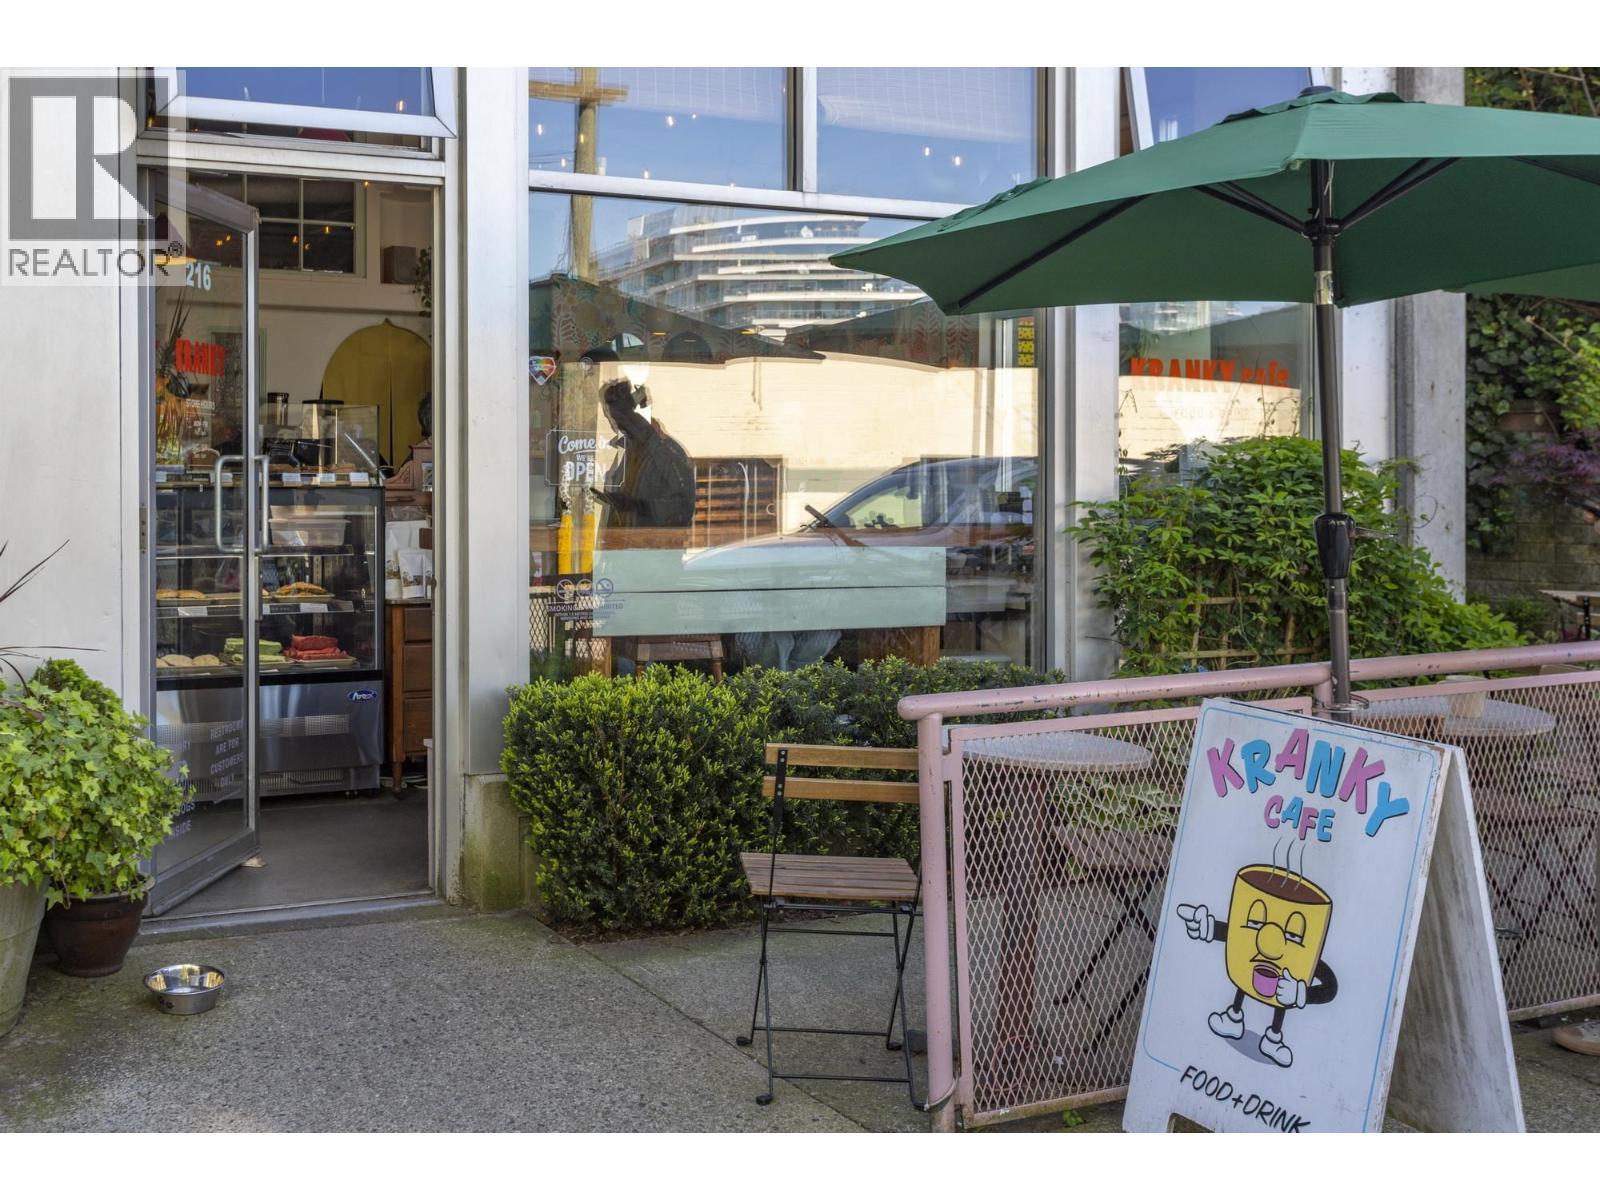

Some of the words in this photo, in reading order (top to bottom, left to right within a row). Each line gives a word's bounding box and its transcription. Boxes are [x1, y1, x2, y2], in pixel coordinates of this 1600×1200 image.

[186, 262, 211, 291] 216
[1130, 357, 1236, 391] KRANKY
[558, 435, 596, 454] Come
[564, 461, 606, 481] OPEN
[1207, 728, 1410, 837] KRANKY
[1264, 794, 1336, 842] CAFE
